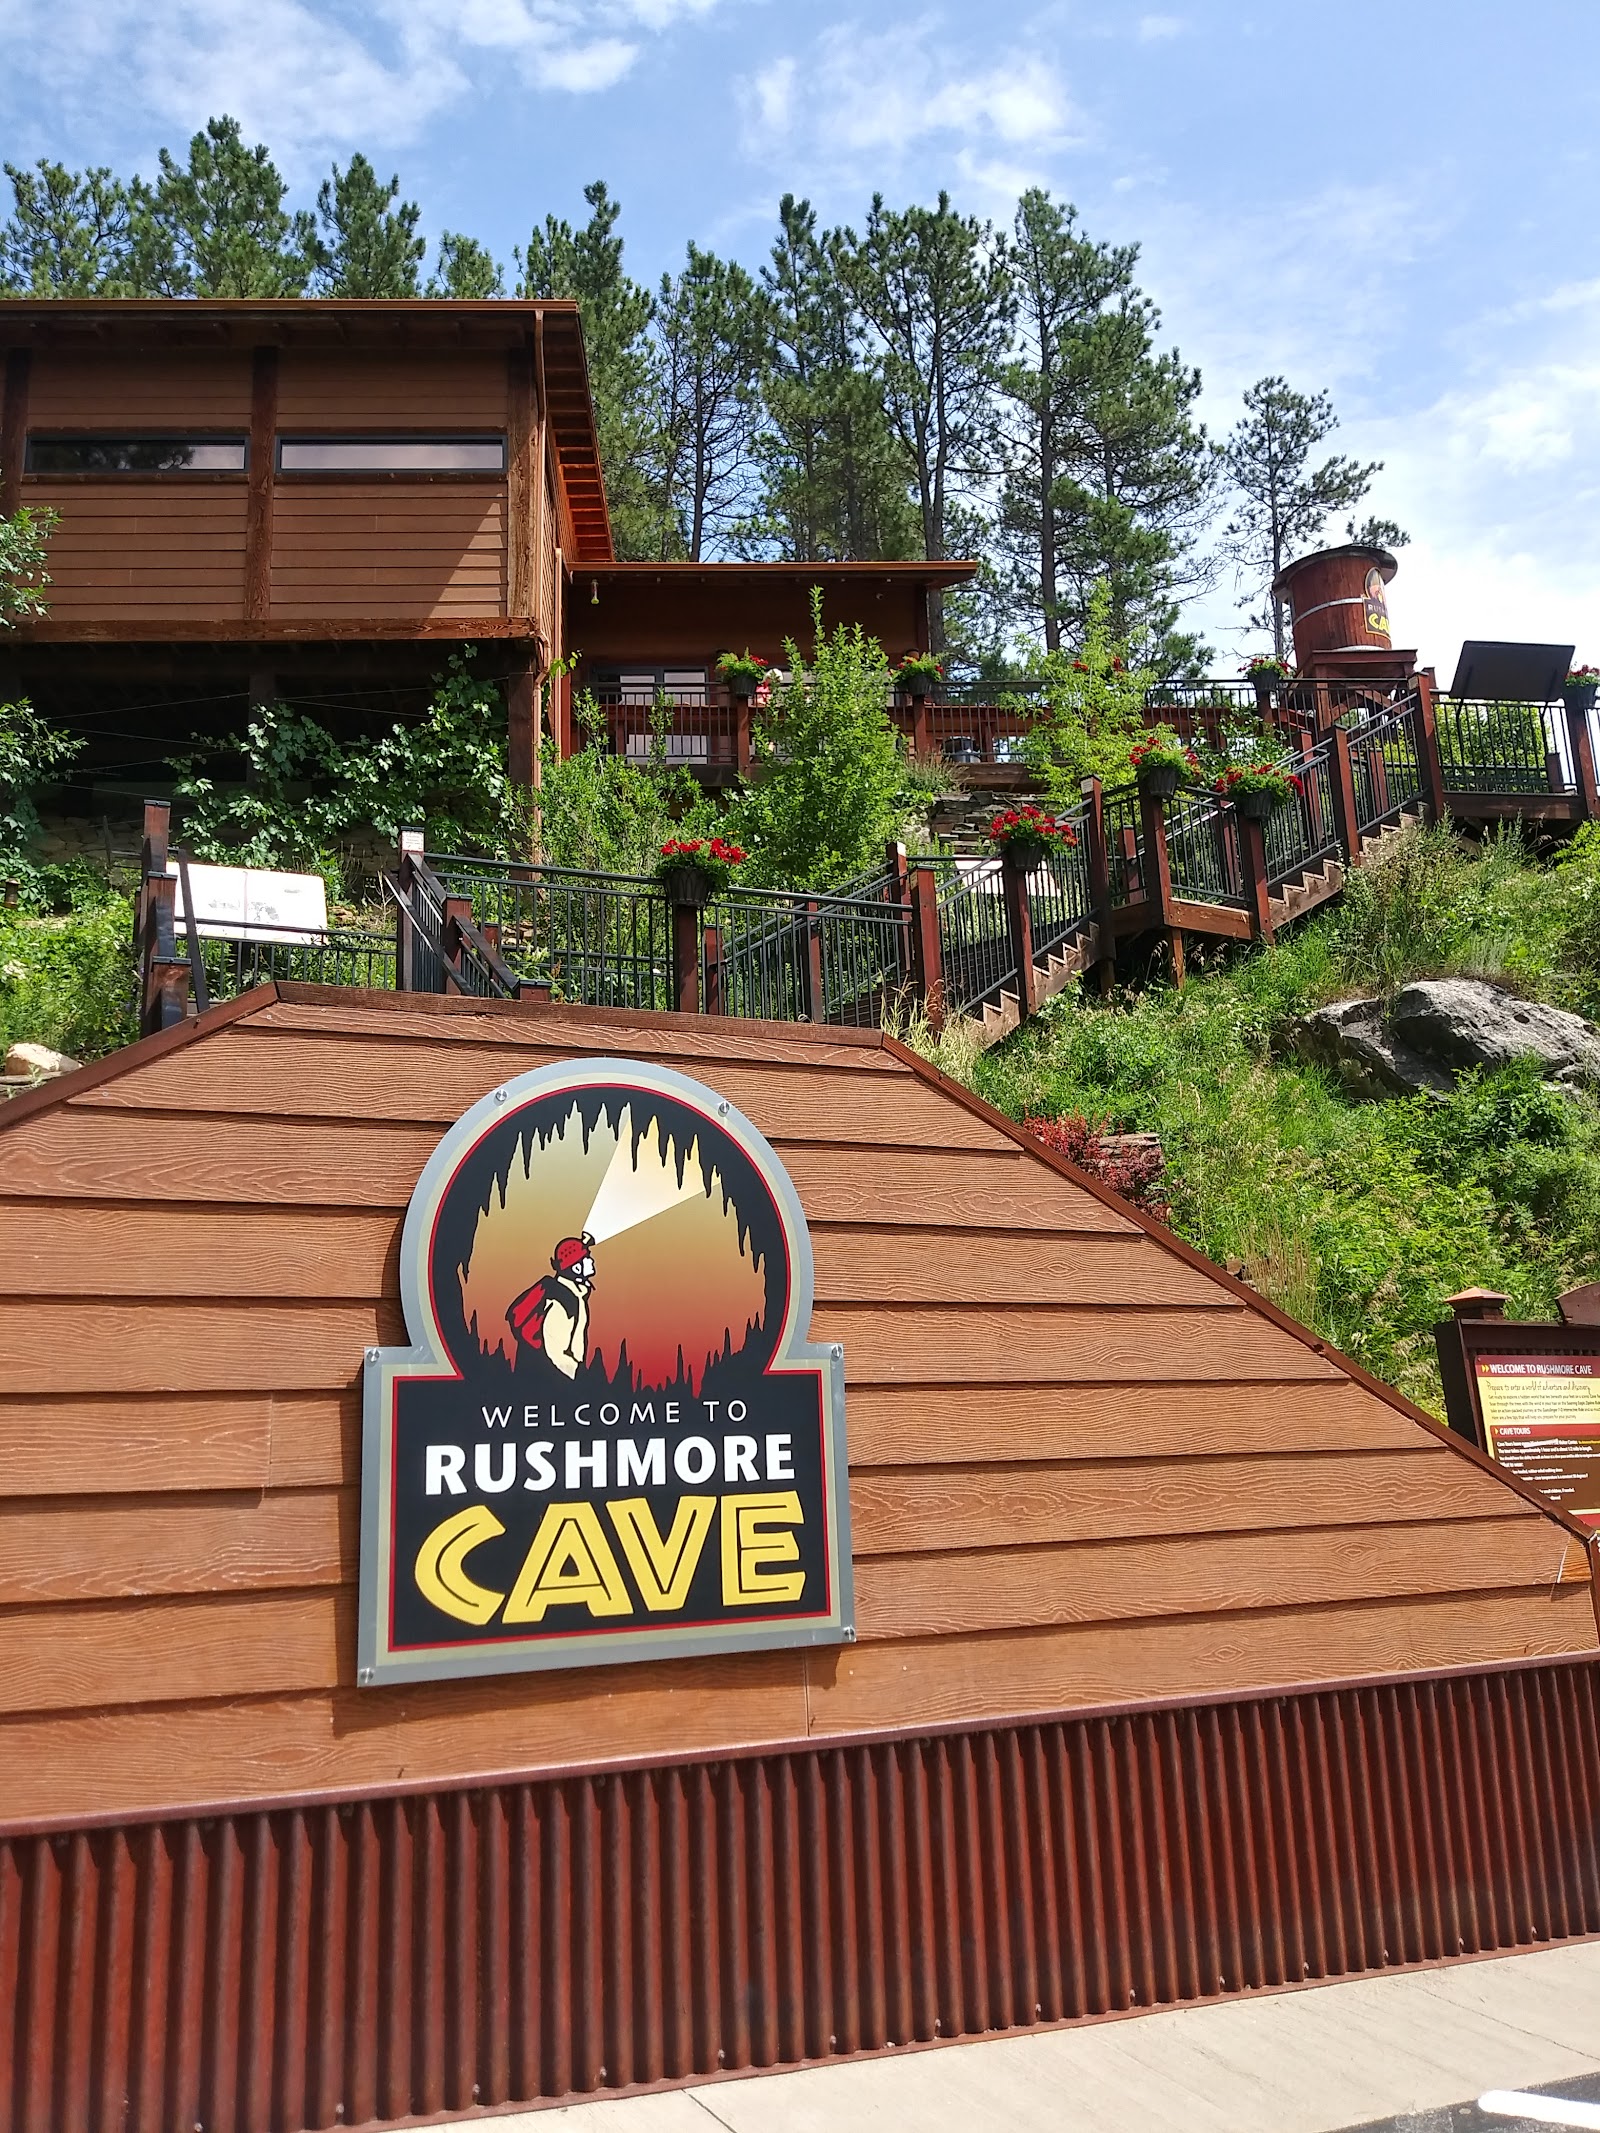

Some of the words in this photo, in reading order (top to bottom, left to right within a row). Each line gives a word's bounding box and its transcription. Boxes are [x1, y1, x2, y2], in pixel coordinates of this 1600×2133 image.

[1490, 1364, 1526, 1374] WELCOME
[1526, 1364, 1536, 1374] TO
[1536, 1364, 1575, 1375] RUSHMORE
[1575, 1365, 1592, 1375] CAVE
[481, 1400, 680, 1428] WELCOME
[703, 1400, 748, 1423] TO
[1500, 1427, 1514, 1436] CAVE
[1514, 1427, 1532, 1435] TOURS
[425, 1433, 796, 1496] RUSHMORE
[415, 1491, 806, 1625] CAVE
